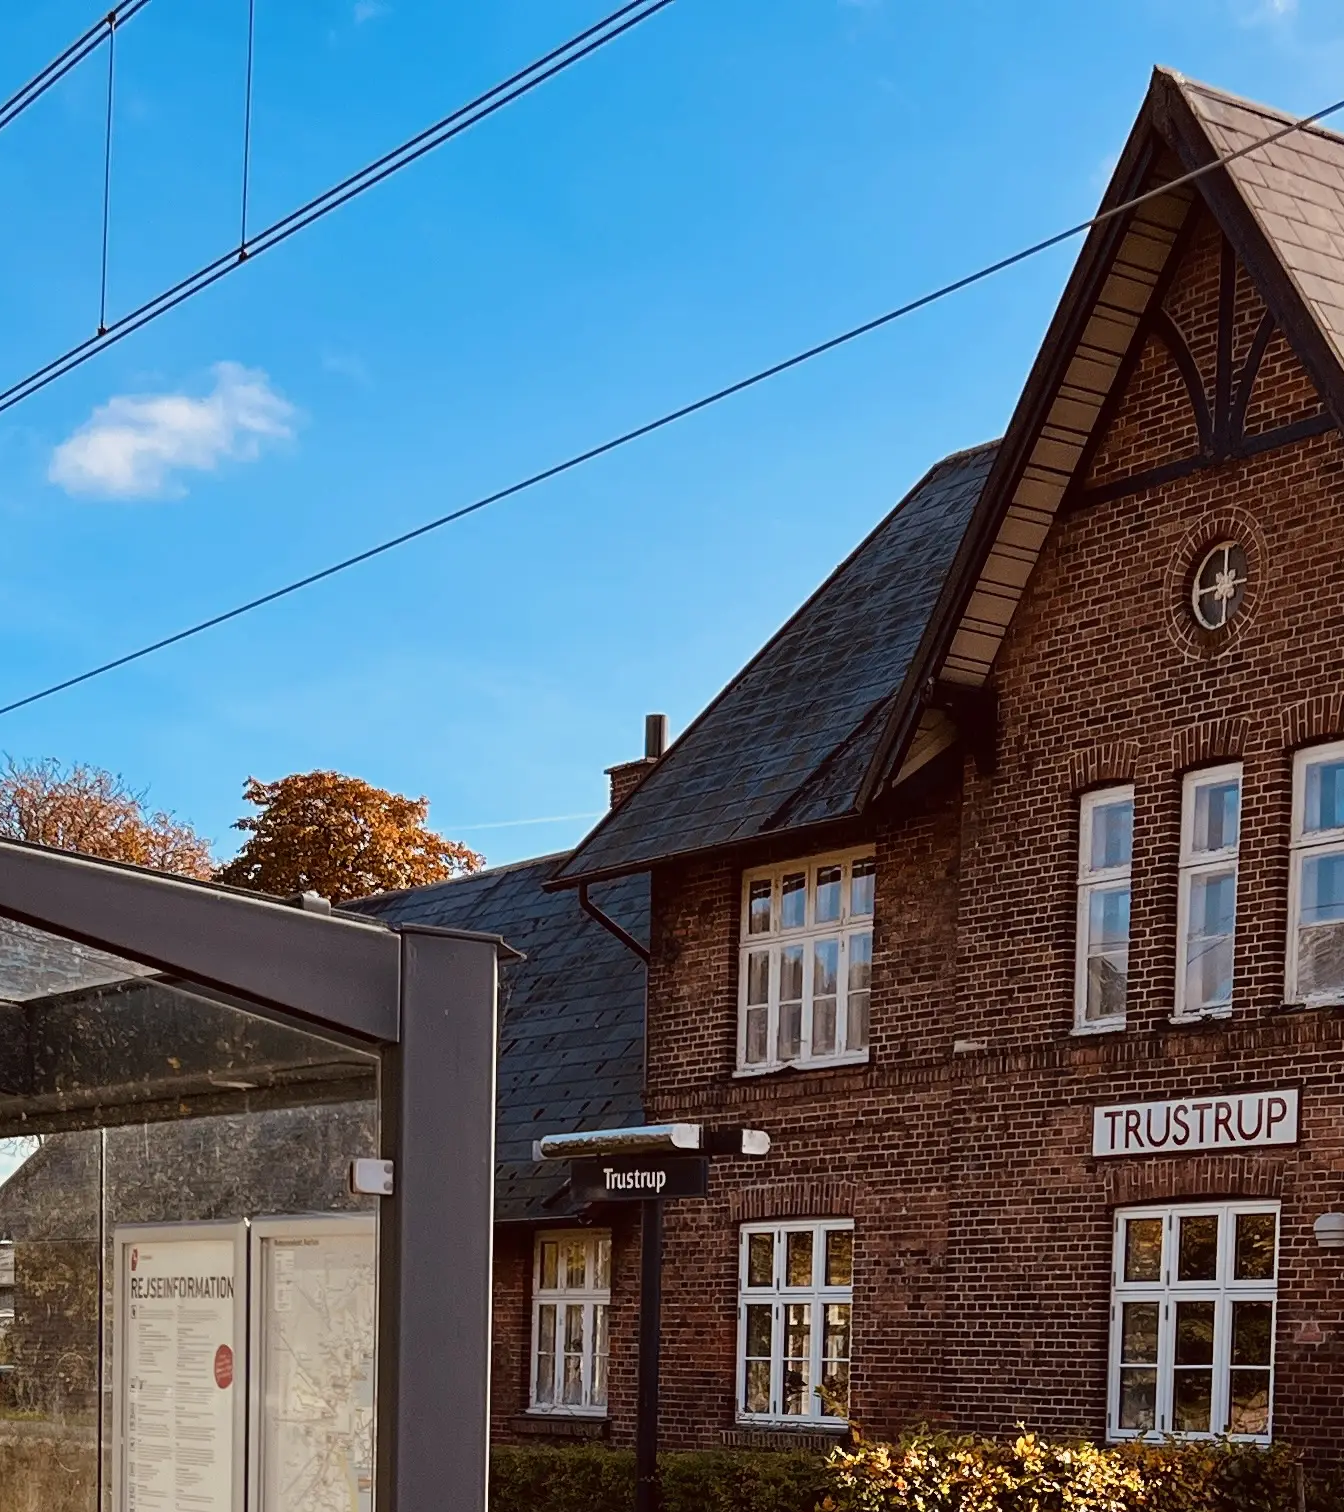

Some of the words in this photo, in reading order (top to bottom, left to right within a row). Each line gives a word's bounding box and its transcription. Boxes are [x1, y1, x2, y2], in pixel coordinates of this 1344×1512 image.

[1104, 1097, 1287, 1150] TRUSTRUP
[602, 1167, 667, 1194] Trustrup
[131, 1276, 235, 1299] REJSEINFORMATION
